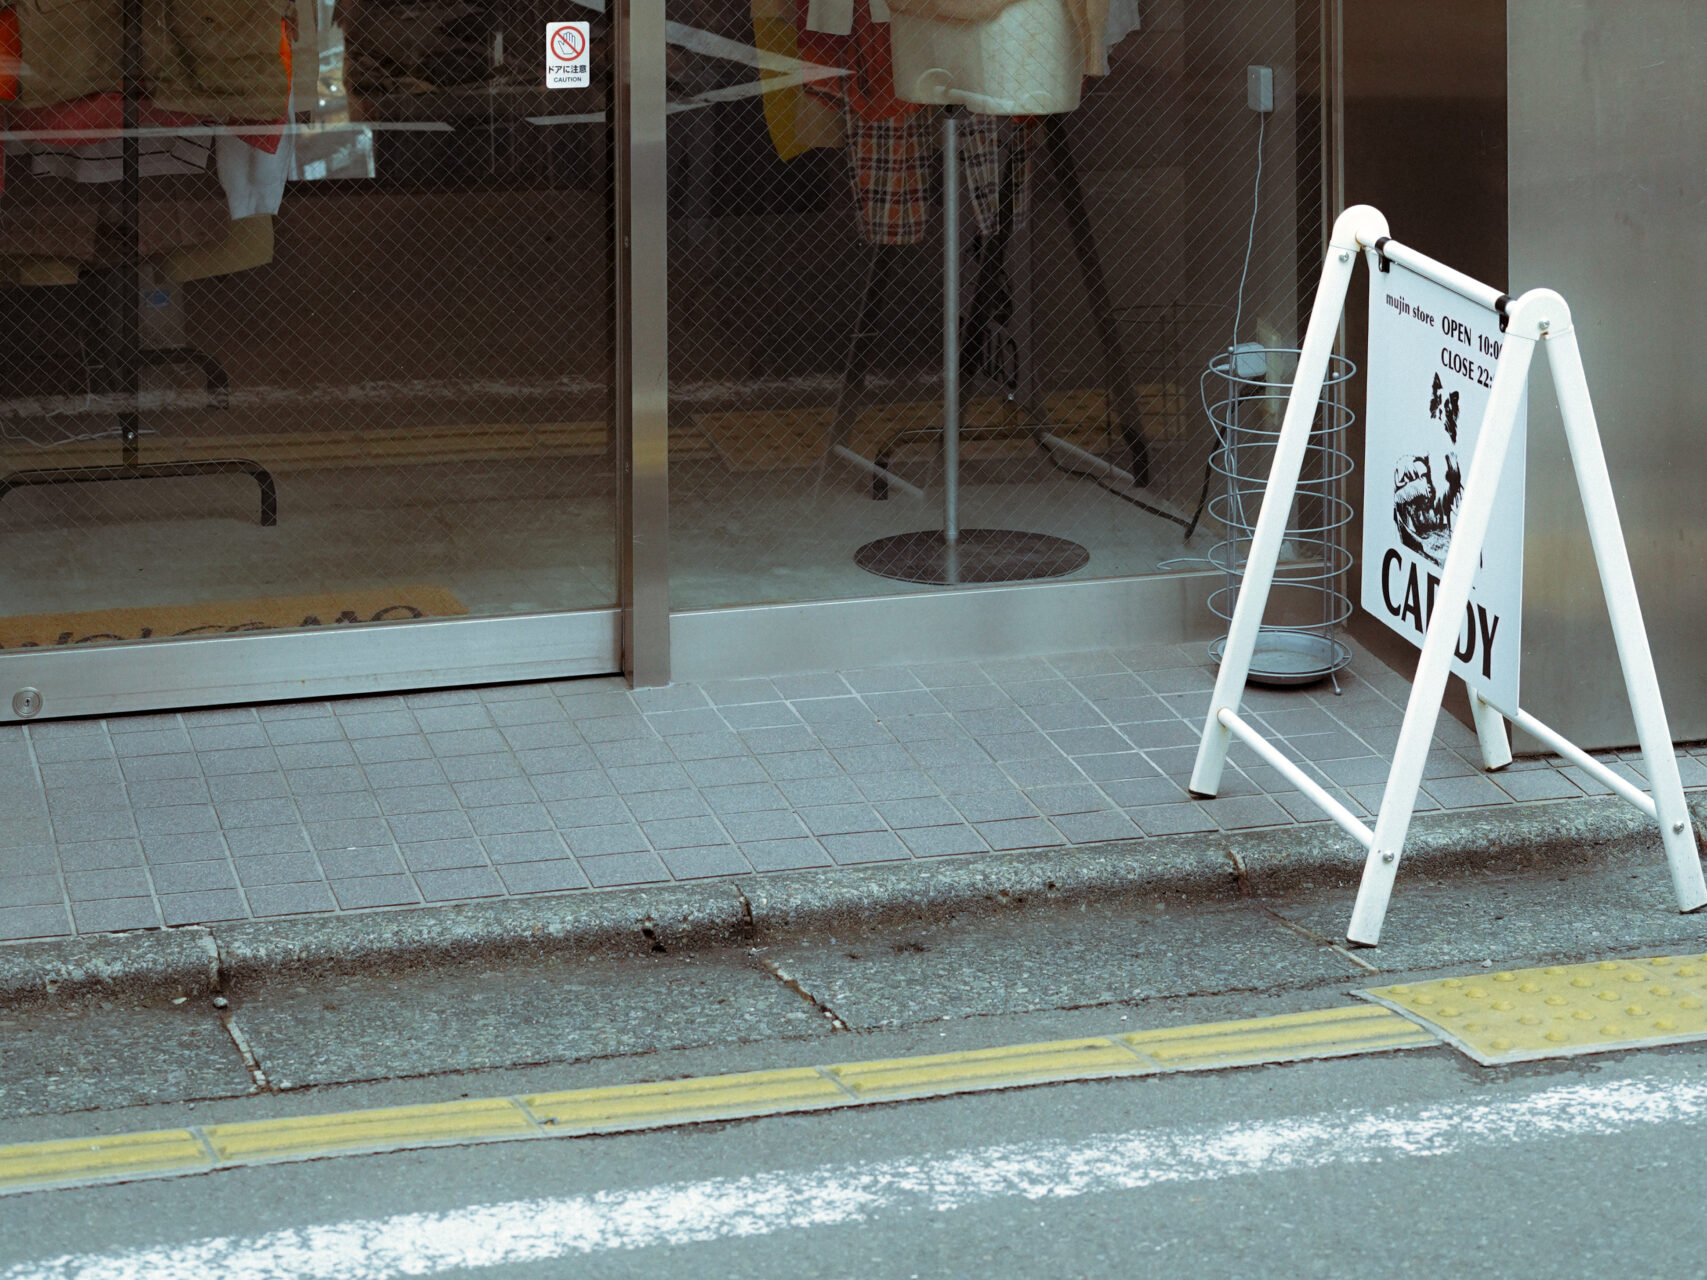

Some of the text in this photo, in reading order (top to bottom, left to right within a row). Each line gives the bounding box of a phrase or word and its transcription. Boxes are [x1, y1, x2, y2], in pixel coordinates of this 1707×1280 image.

[548, 65, 587, 74] ドアに注意
[1386, 293, 1435, 327] mujin store
[1441, 315, 1503, 361] OPEN 10:0
[1441, 347, 1475, 381] CLOSE
